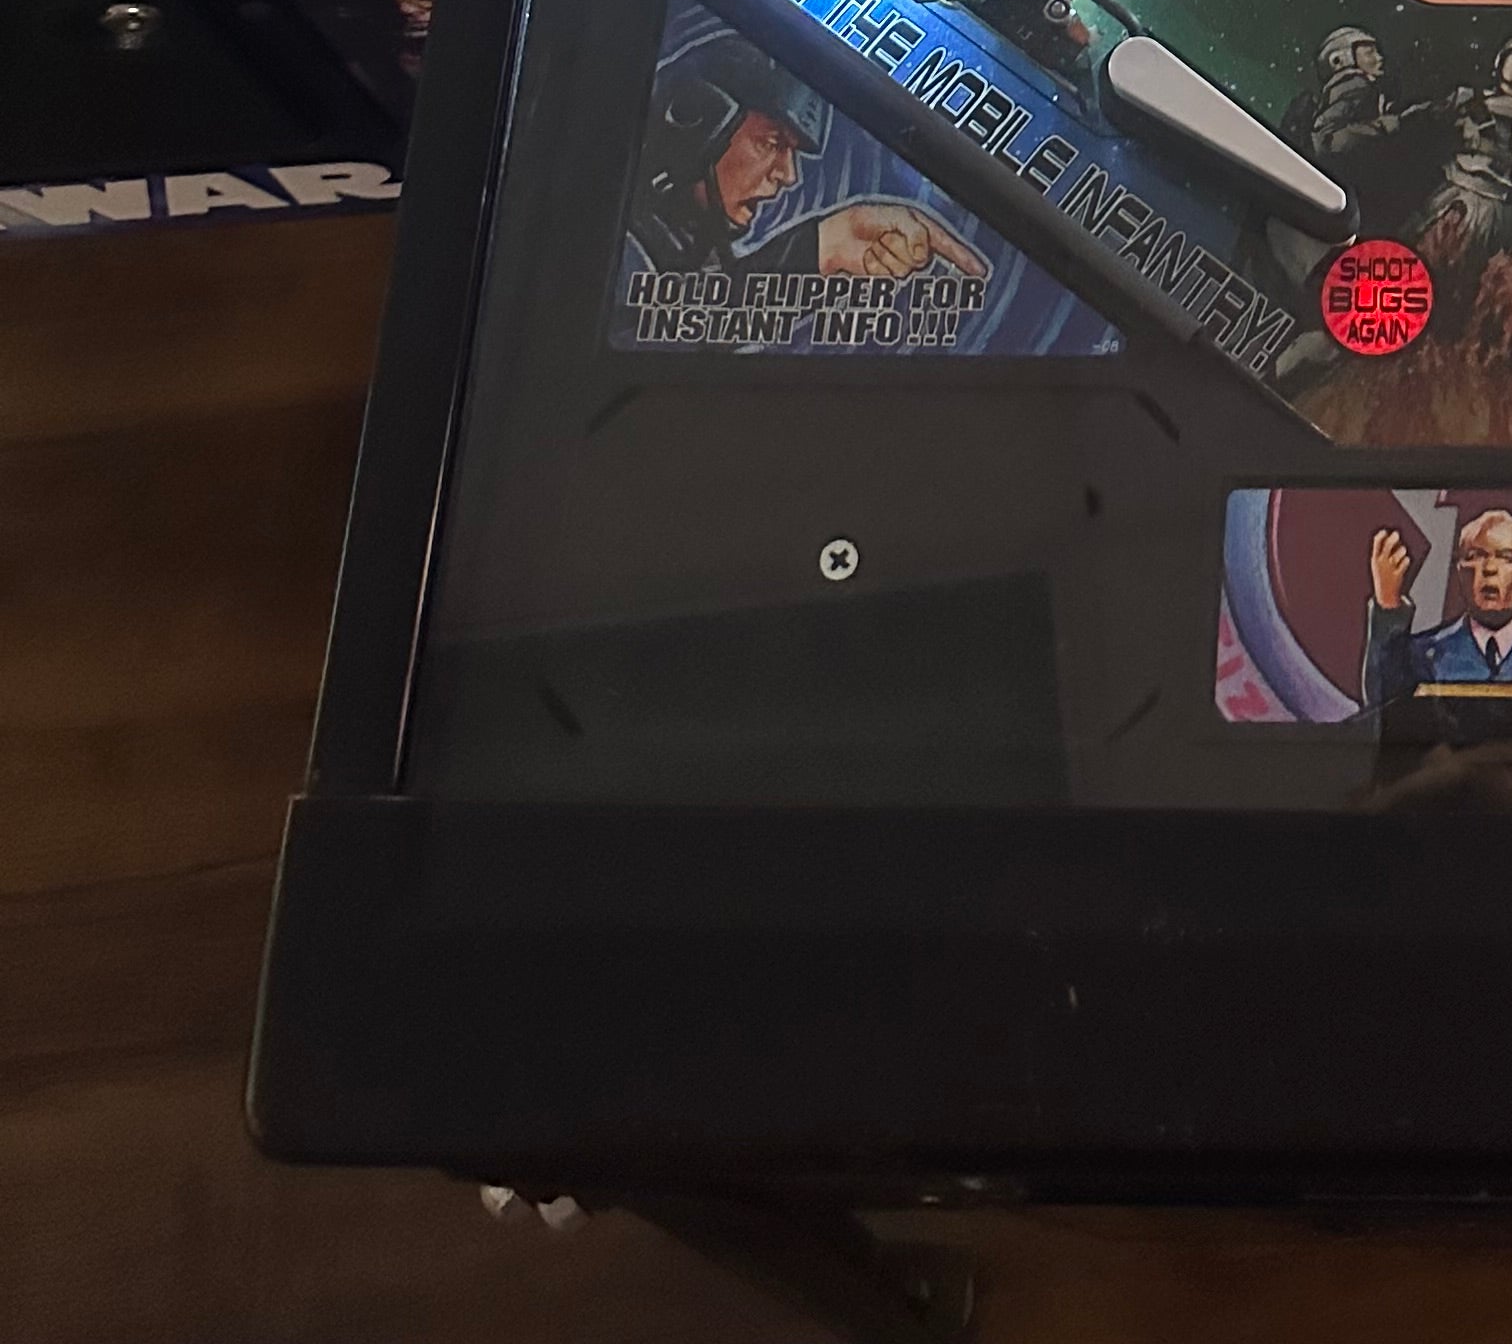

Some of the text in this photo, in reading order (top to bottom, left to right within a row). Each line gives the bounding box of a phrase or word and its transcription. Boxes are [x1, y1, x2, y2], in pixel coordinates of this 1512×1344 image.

[903, 46, 1080, 196] MOBILE
[1056, 162, 1296, 373] INFANTRY!
[1339, 257, 1419, 283] SHOOT
[626, 272, 988, 312] HOLD FLIPPER FOR
[1327, 286, 1429, 314] BUGS
[636, 307, 801, 344] INSTANT
[1345, 318, 1410, 345] AGAIN
